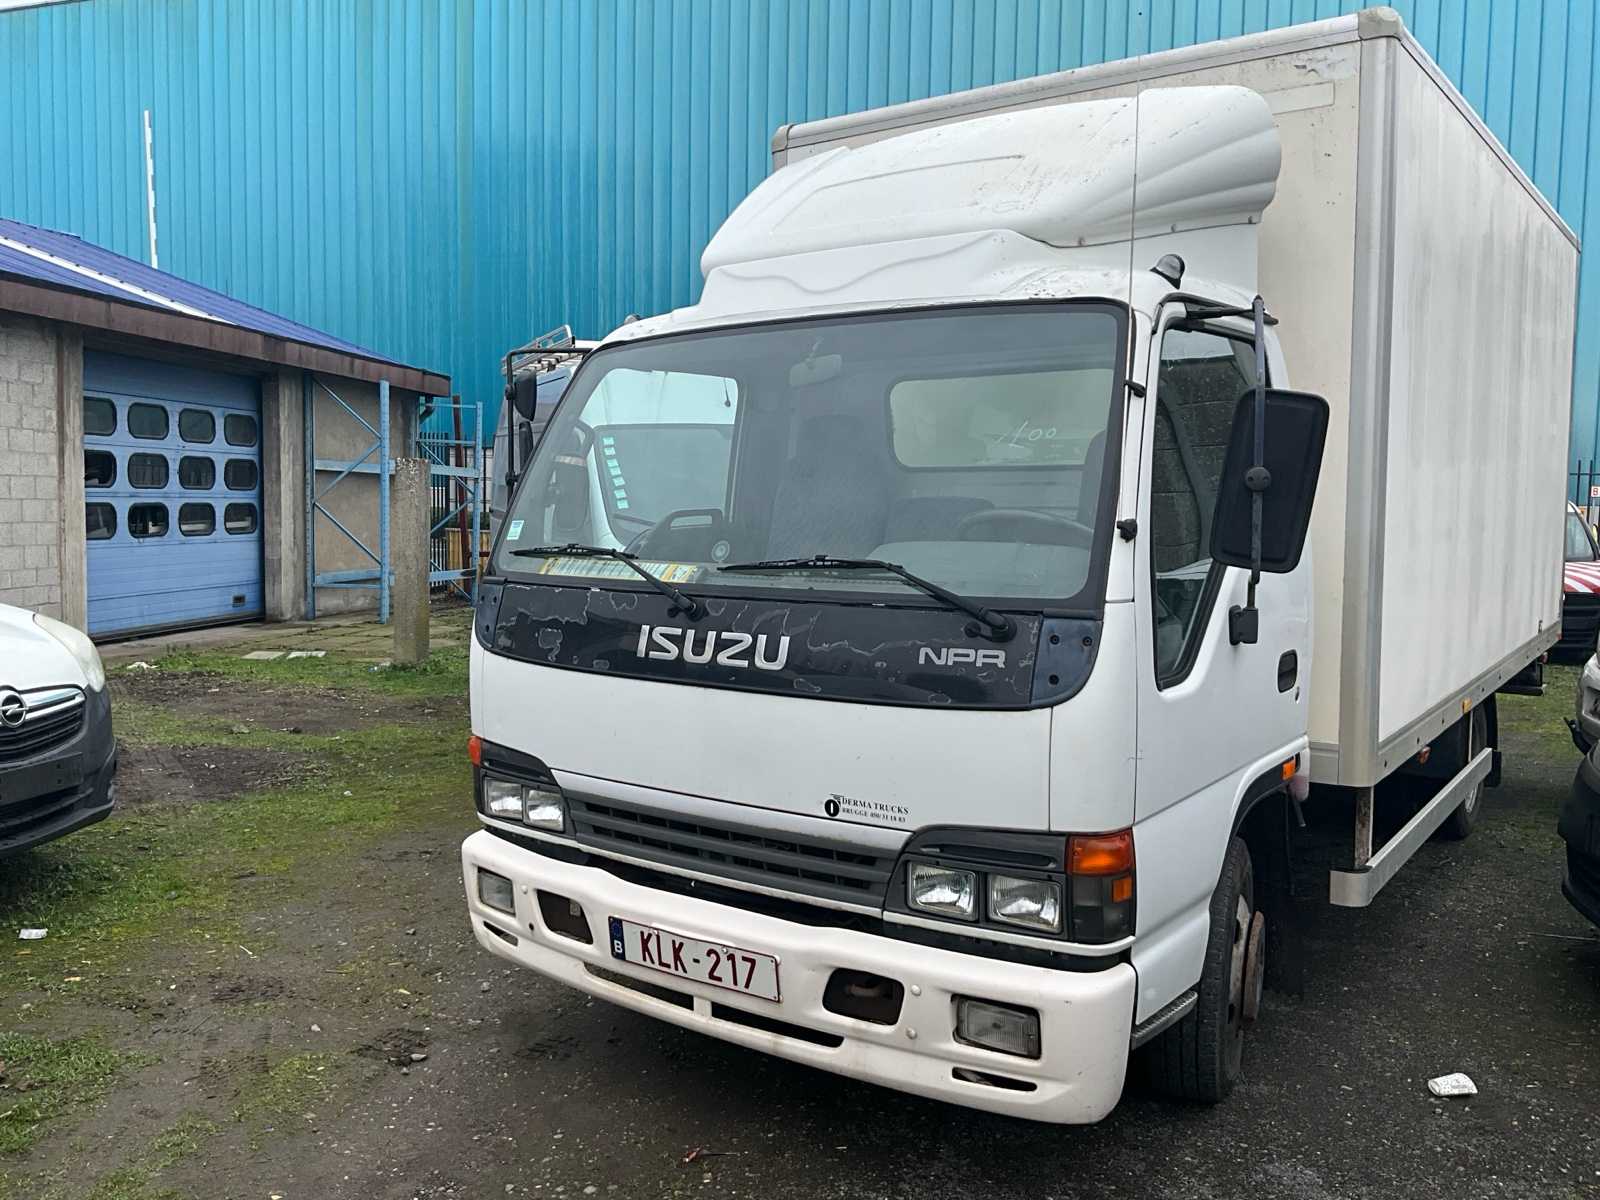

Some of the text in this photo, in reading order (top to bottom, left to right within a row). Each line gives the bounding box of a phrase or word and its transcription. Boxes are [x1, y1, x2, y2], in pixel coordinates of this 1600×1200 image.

[636, 625, 791, 671] ISUZU
[918, 647, 1006, 668] NPR
[842, 796, 909, 815] DERMA TRUCKS
[842, 808, 867, 816] BRUGGE
[614, 939, 623, 953] B
[640, 930, 757, 989] KLK-217
